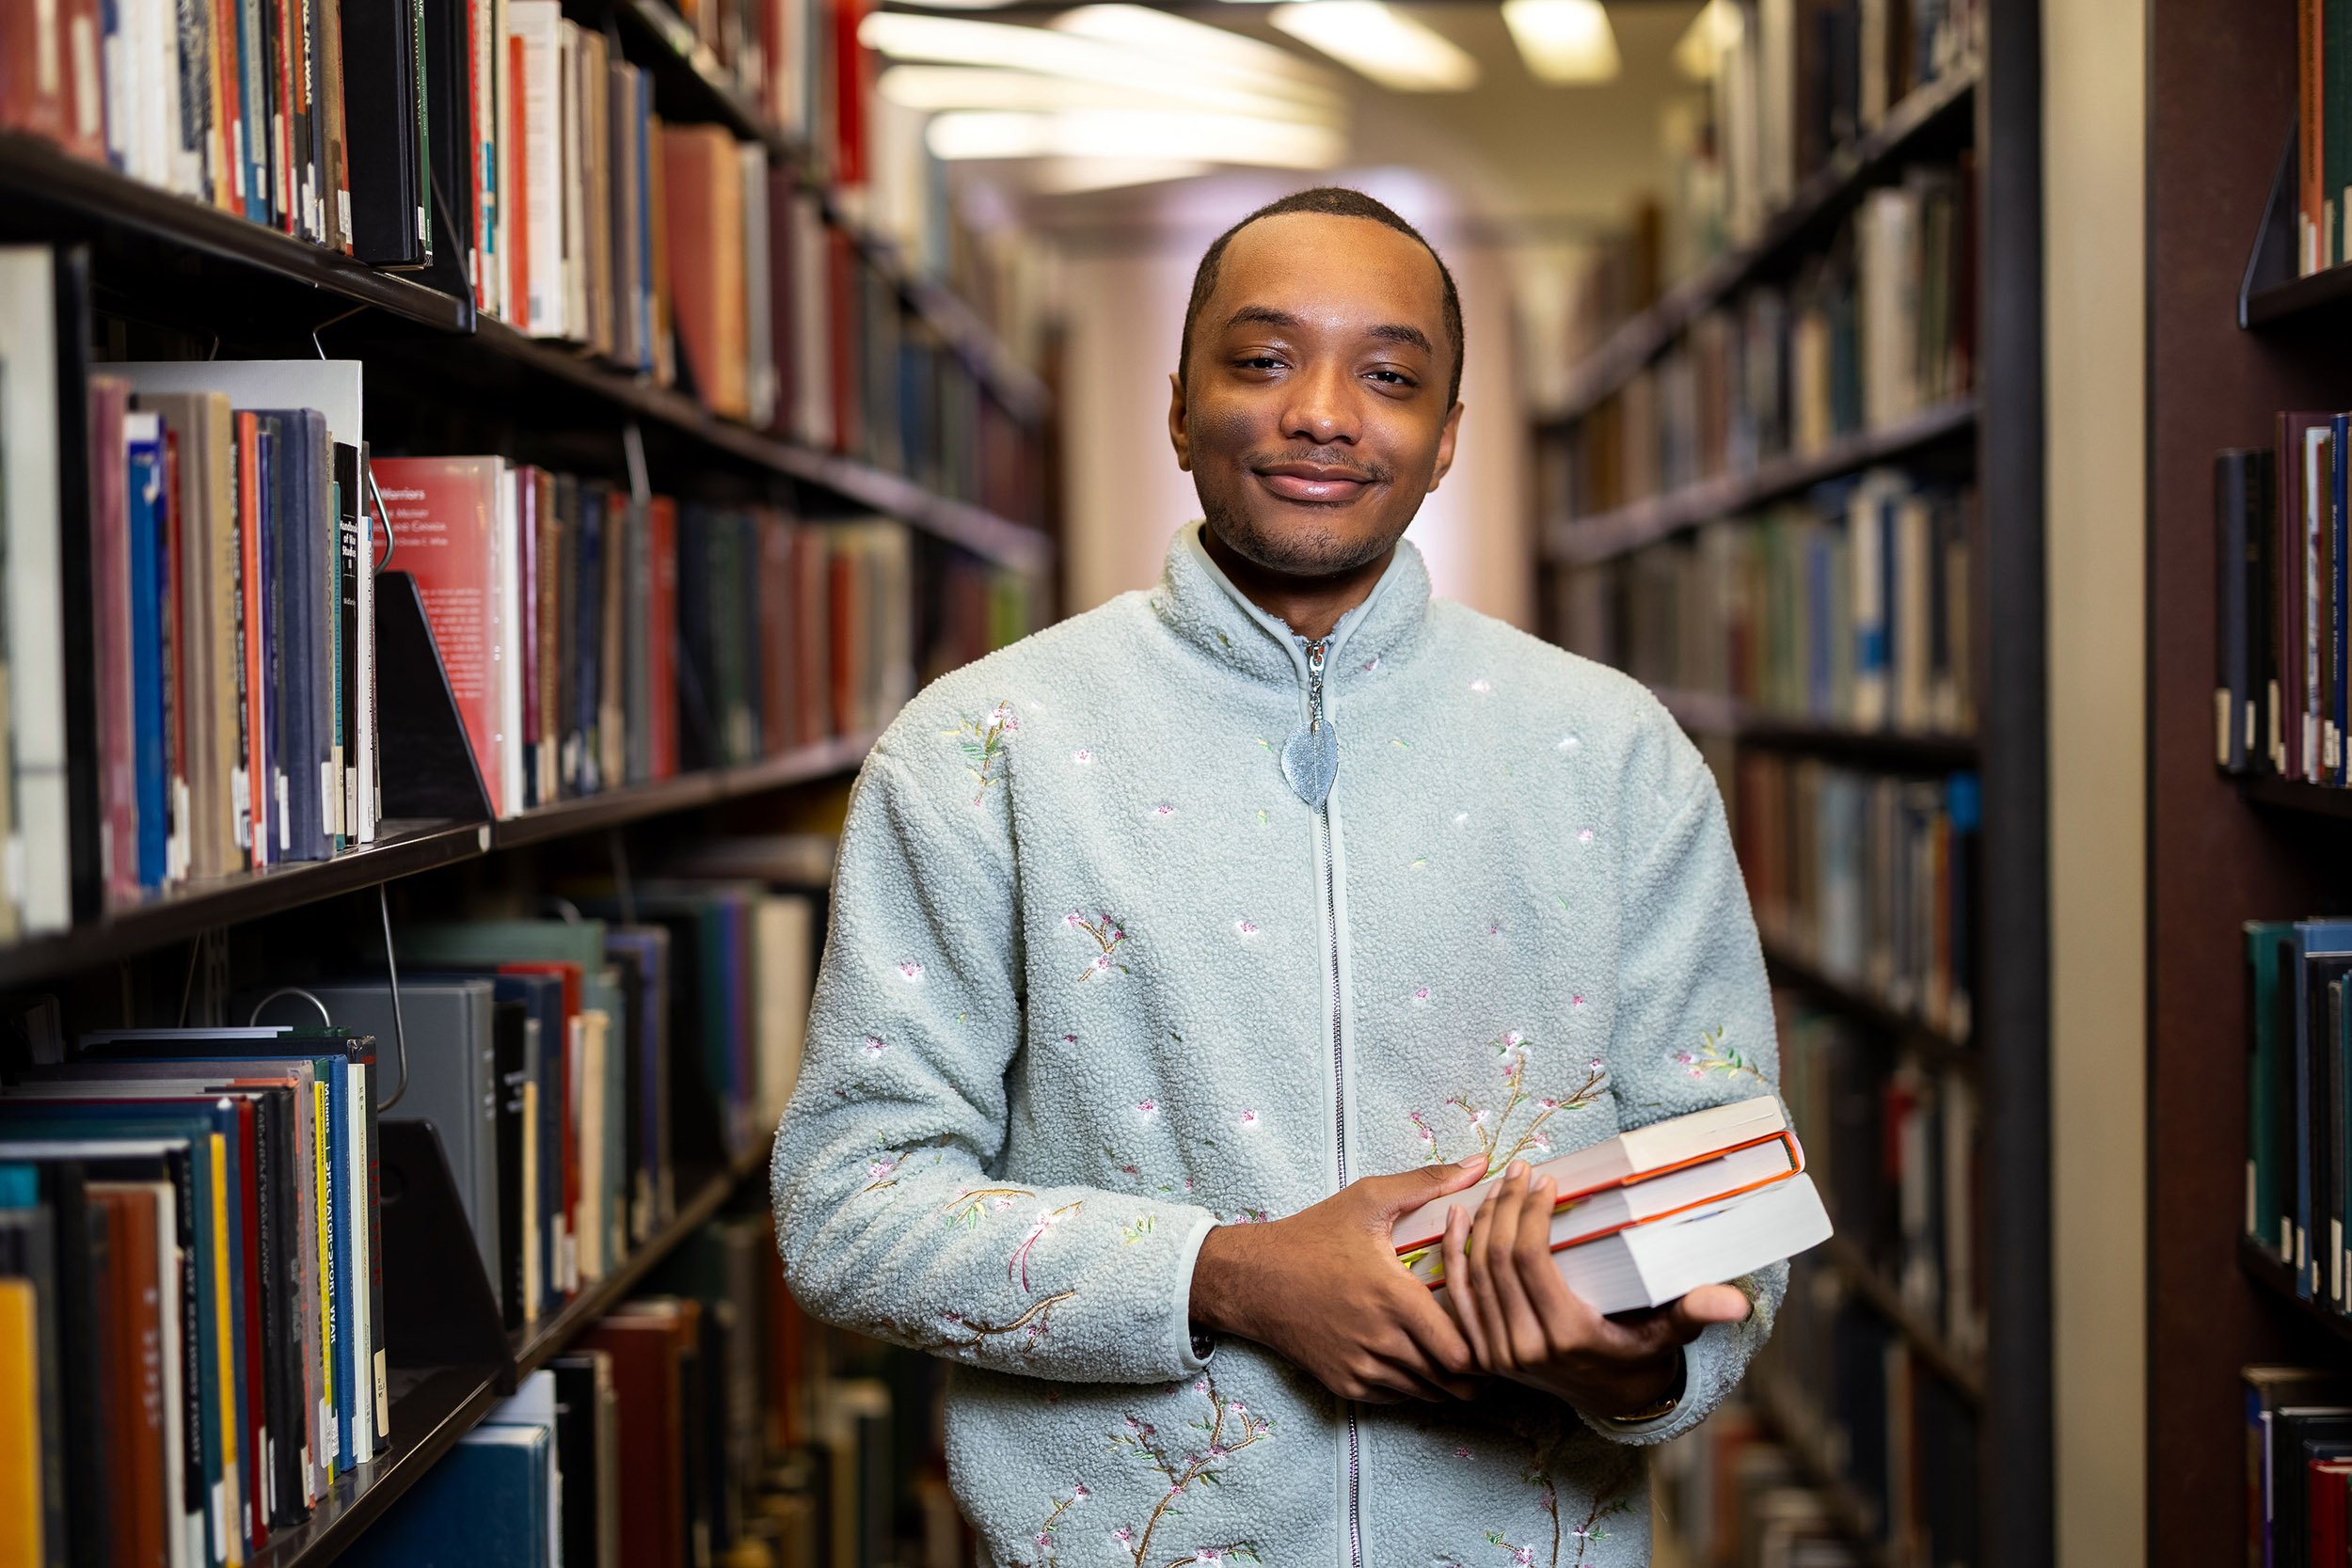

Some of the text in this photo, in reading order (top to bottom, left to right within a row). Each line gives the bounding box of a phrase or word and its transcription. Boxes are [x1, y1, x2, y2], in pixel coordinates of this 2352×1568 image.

[305, 60, 313, 104] WAR
[342, 546, 357, 558] Studies
[343, 532, 349, 544] of
[370, 1160, 383, 1287] ON WAR
